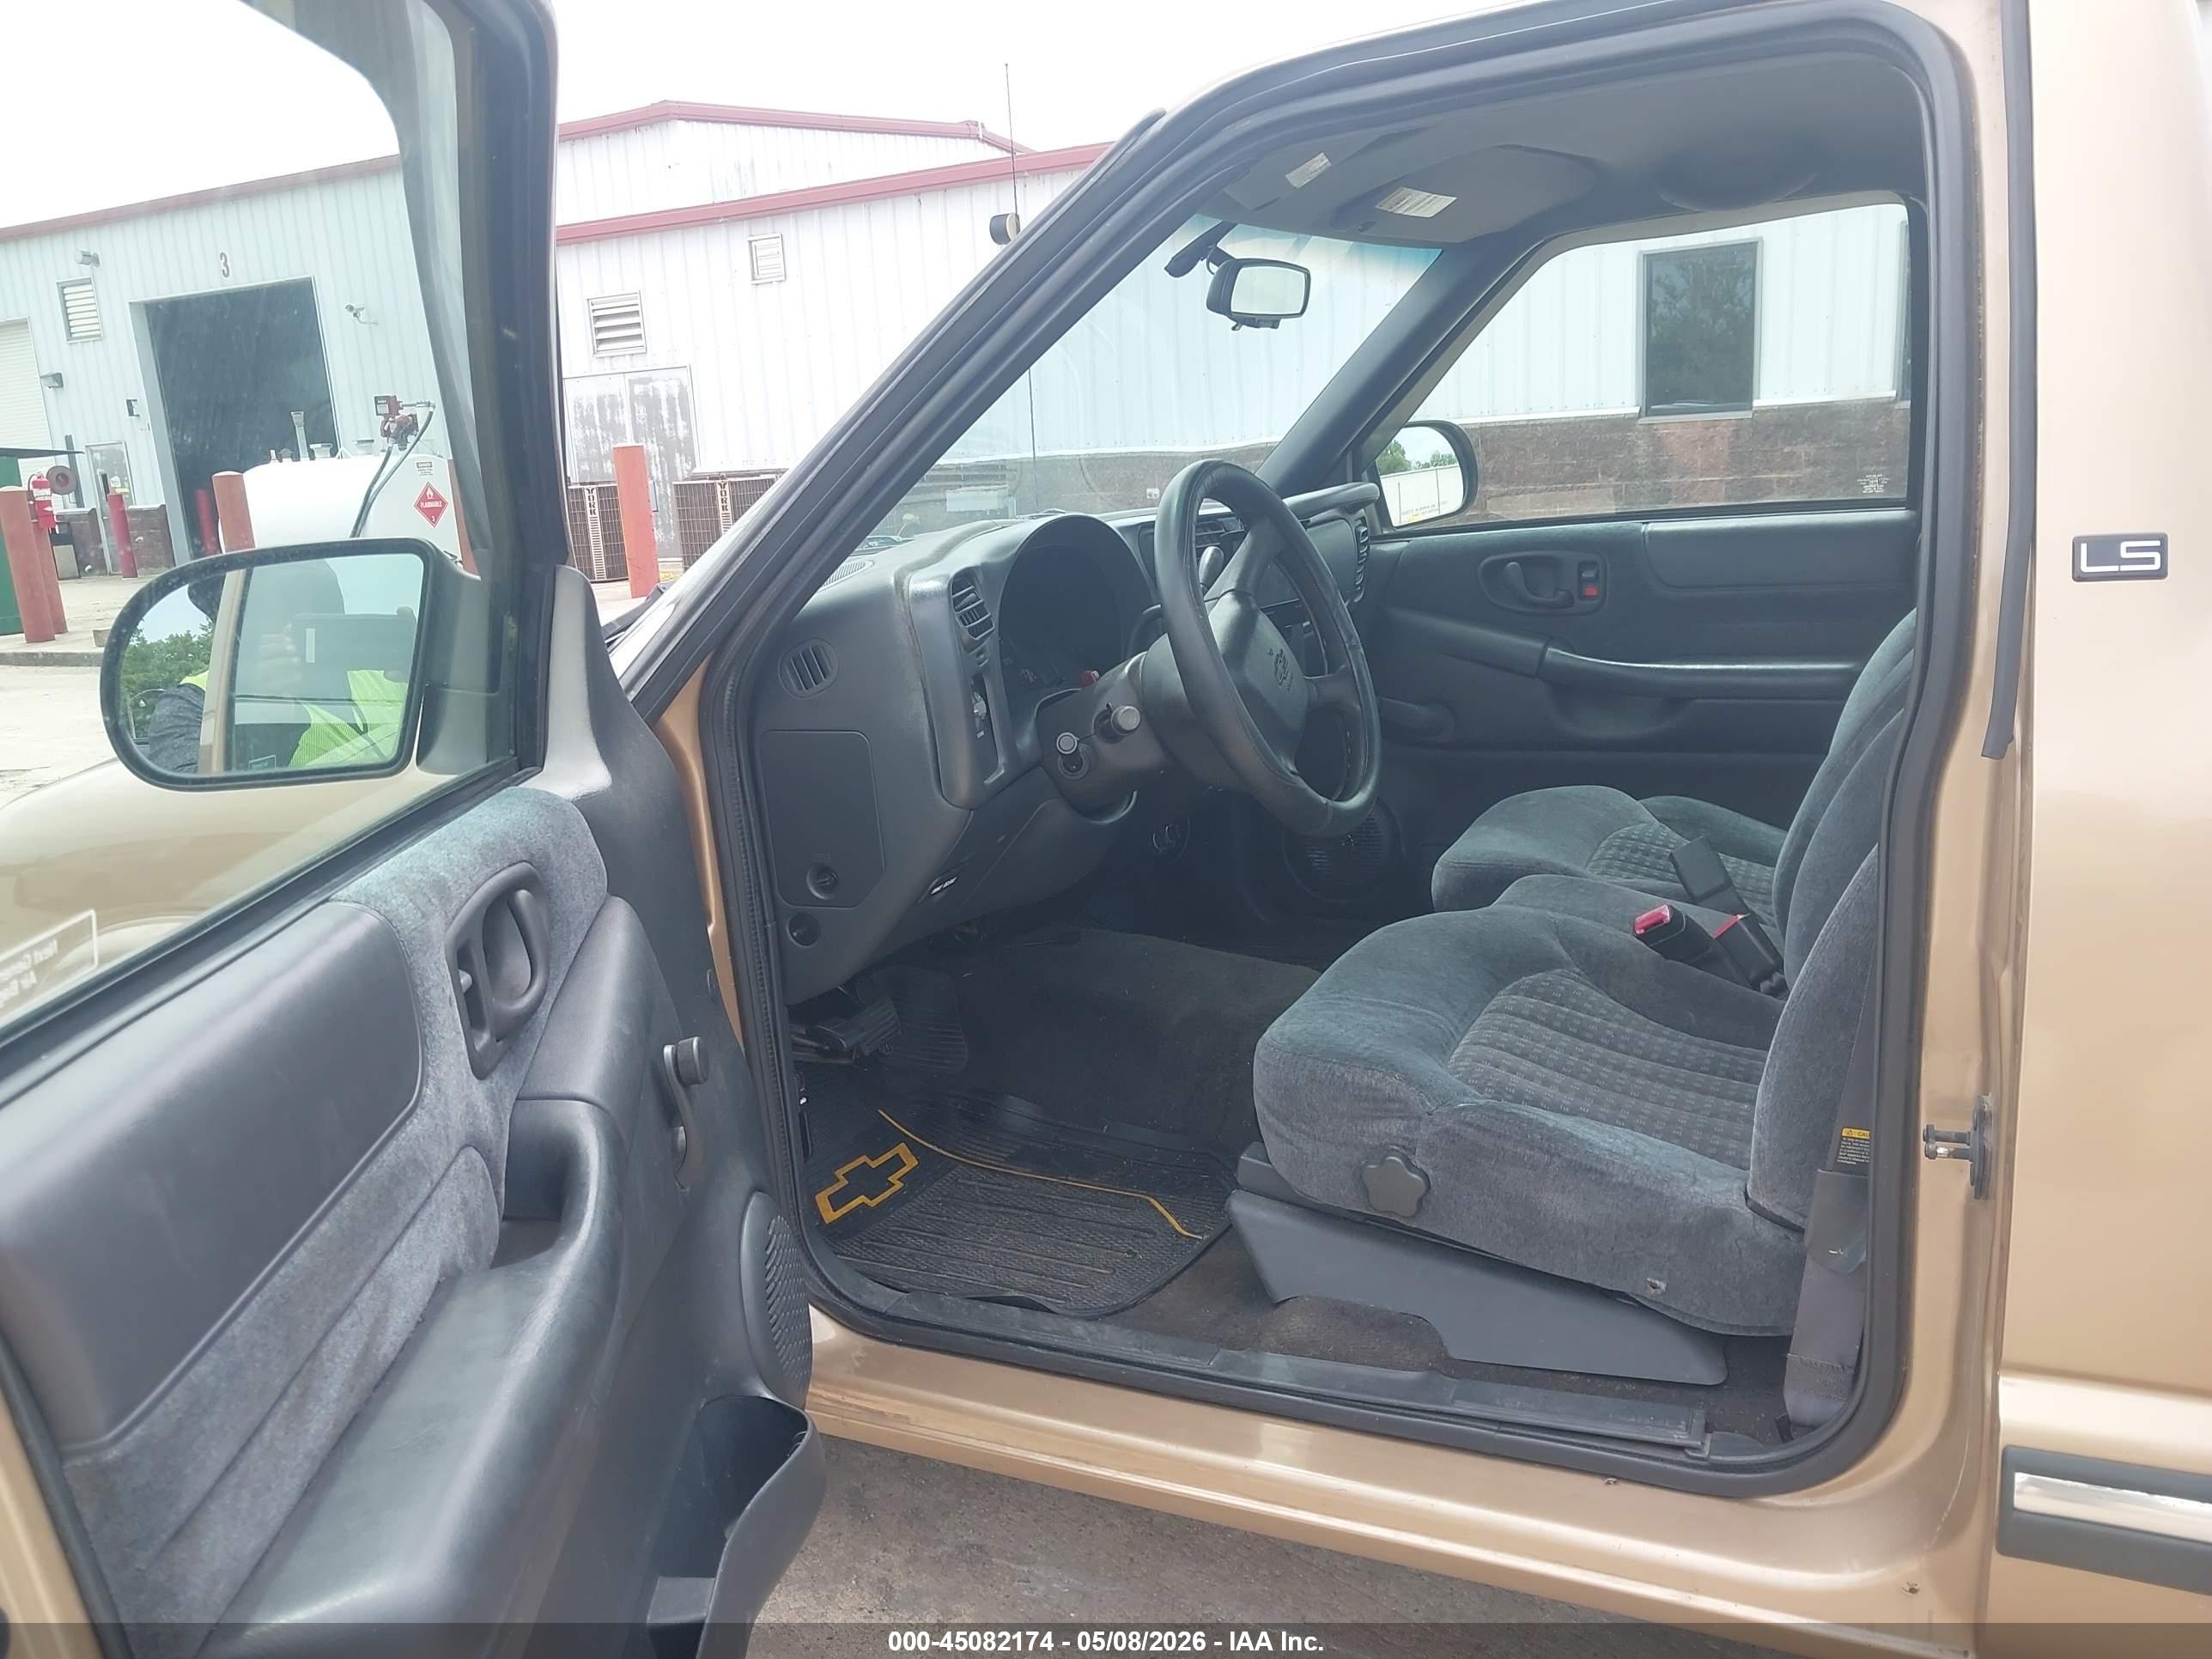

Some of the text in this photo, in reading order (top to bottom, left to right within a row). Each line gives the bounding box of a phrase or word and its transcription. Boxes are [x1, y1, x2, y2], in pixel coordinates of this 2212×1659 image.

[219, 252, 230, 278] 3
[420, 500, 442, 508] FLAMMABLE
[586, 488, 596, 516] YORK
[718, 482, 728, 512] YORK
[2081, 540, 2161, 573] LS
